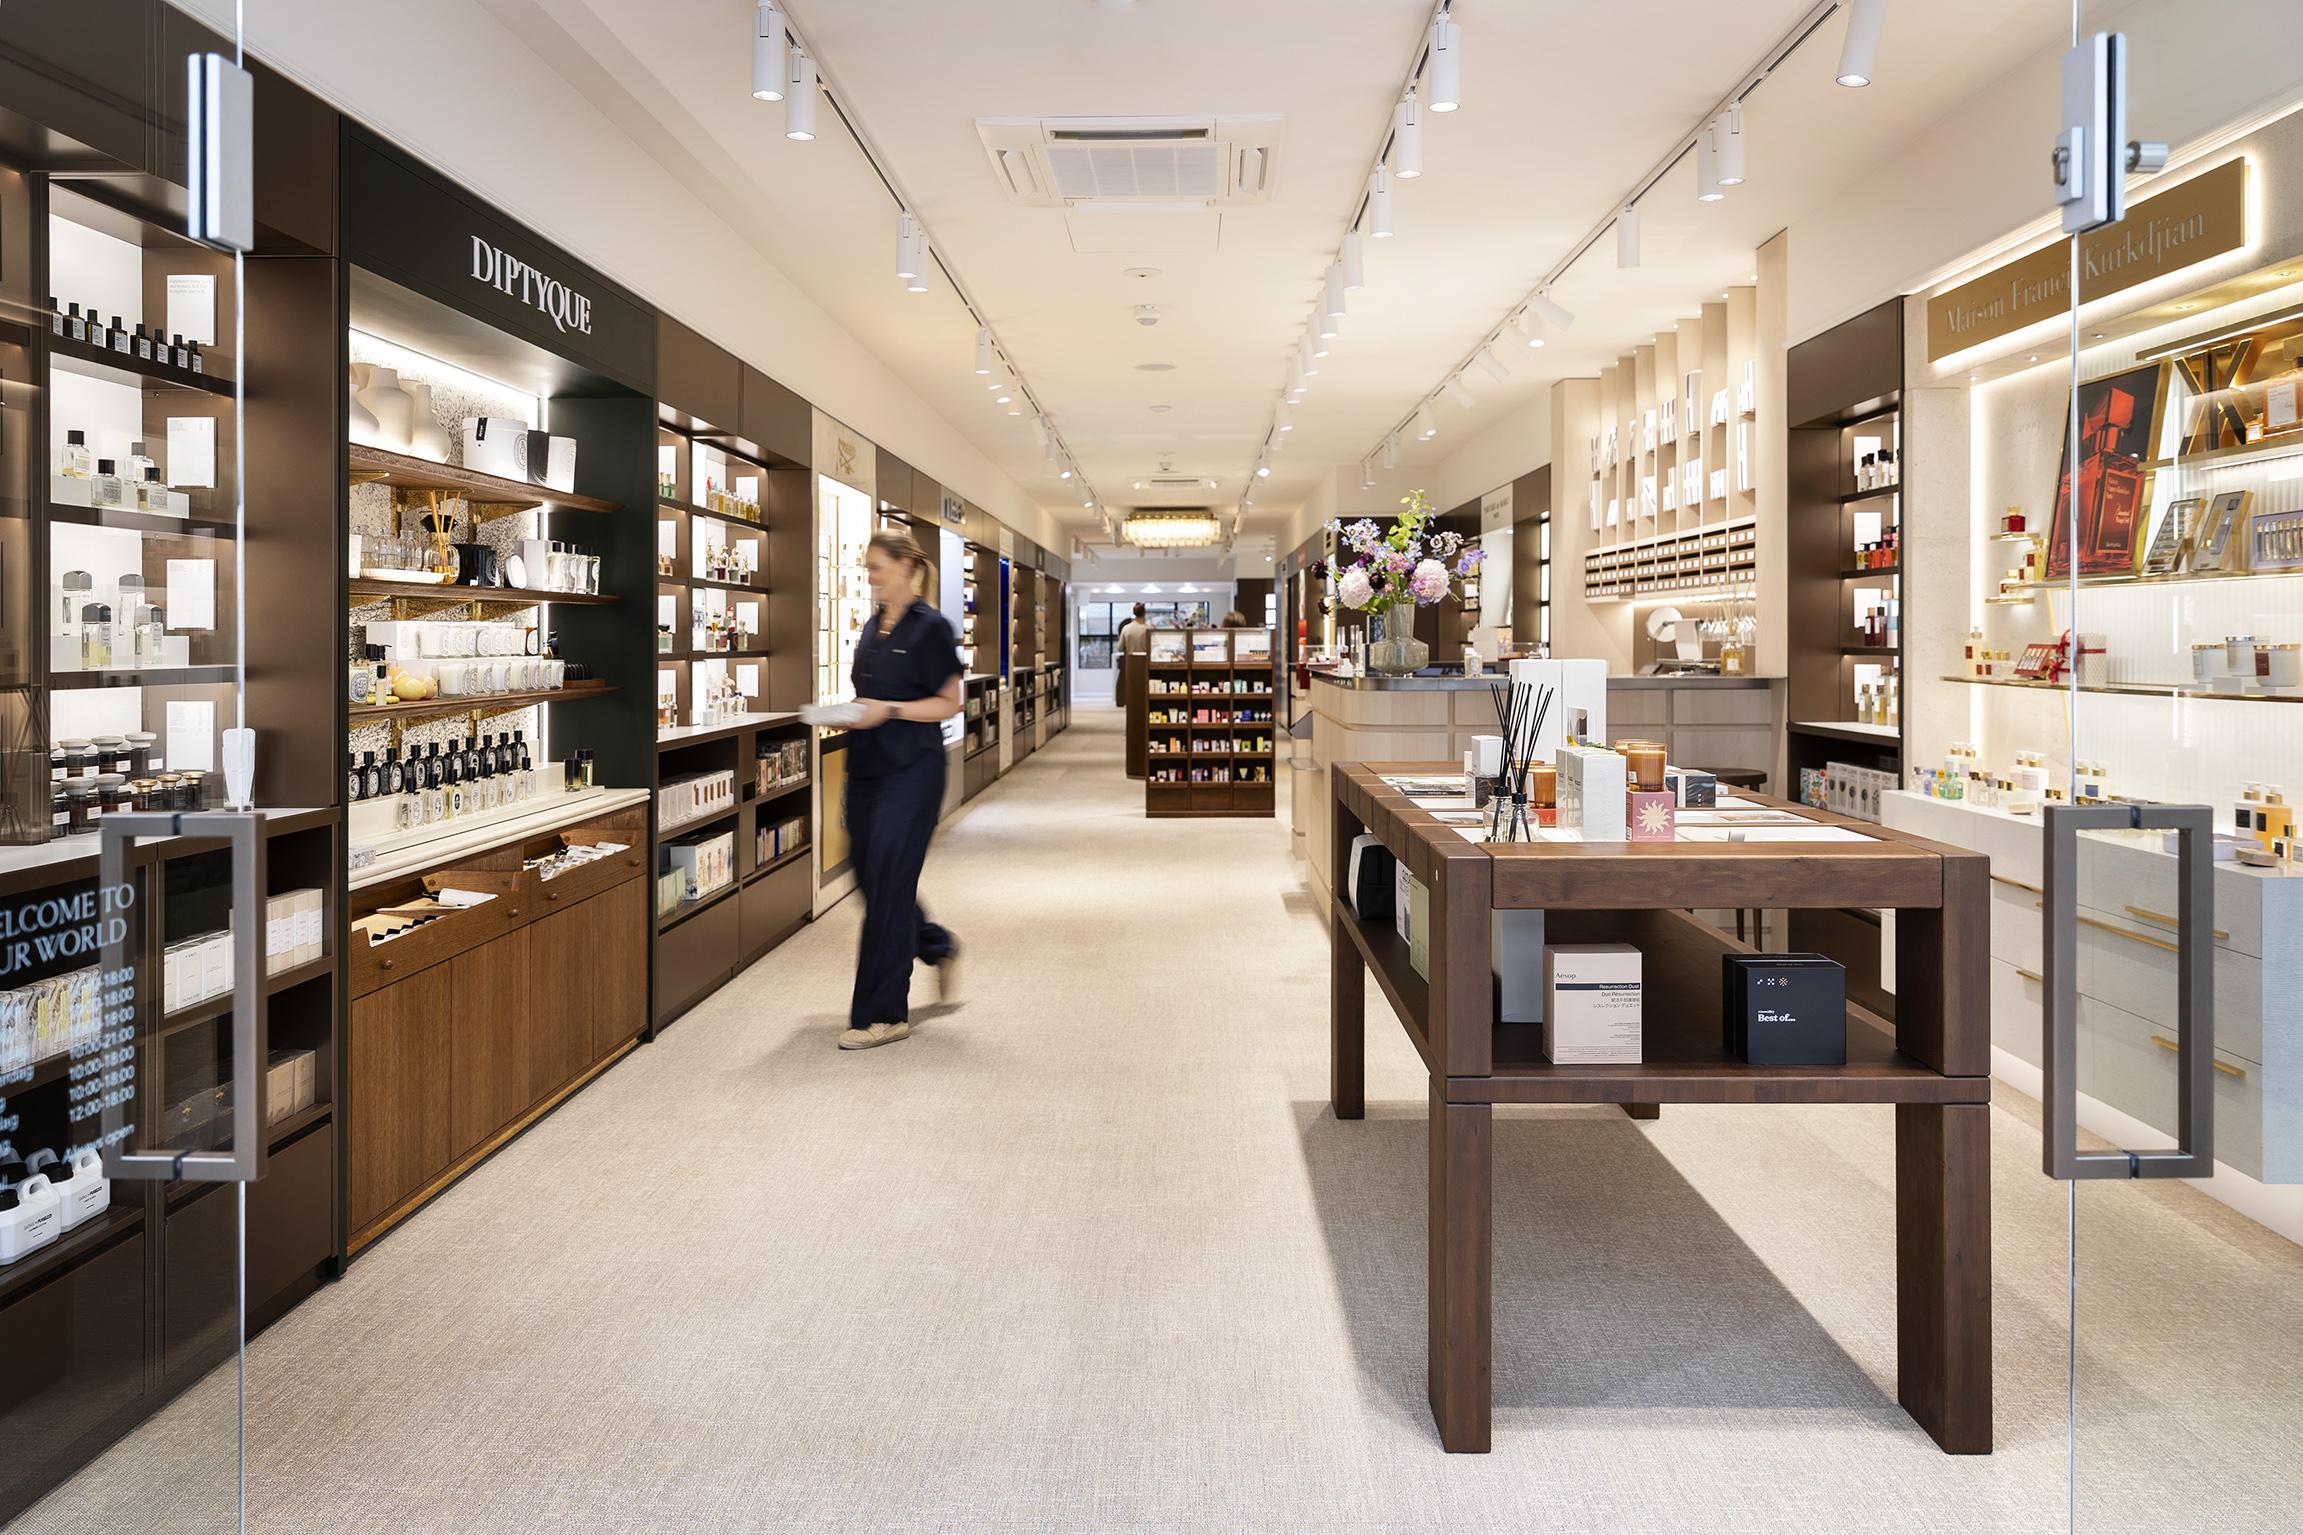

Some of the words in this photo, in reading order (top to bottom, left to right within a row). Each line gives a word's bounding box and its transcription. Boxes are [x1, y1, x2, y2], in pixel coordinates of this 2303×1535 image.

[470, 234, 593, 335] DIPTYQUE
[1945, 296, 2004, 338] Maison
[2010, 260, 2073, 313] Franci
[2082, 213, 2204, 283] Kurkdjian
[100, 883, 135, 913] TO
[33, 917, 127, 963] WORLD
[1779, 1013, 1796, 1022] of...
[69, 1026, 135, 1060] 10:00-21:00
[69, 1045, 135, 1081] 10:00-18:00
[69, 1064, 135, 1102] 10:00-18:00
[69, 1085, 135, 1123] 12:00-18:00
[105, 1124, 135, 1148] open
